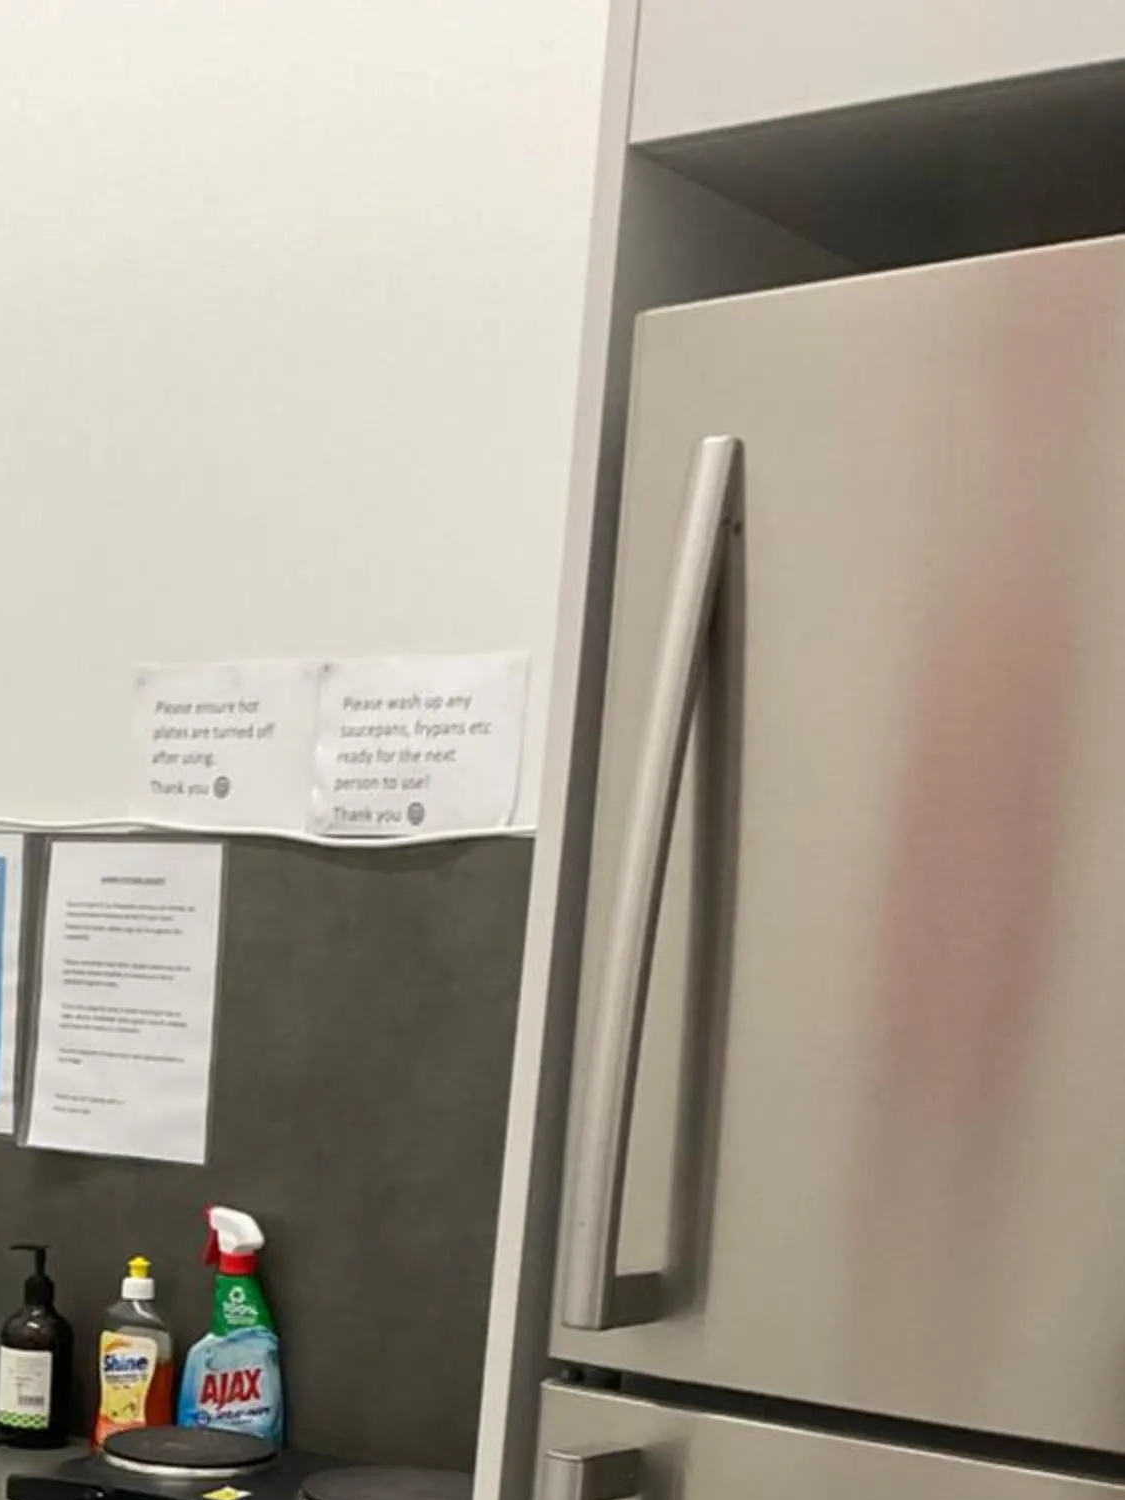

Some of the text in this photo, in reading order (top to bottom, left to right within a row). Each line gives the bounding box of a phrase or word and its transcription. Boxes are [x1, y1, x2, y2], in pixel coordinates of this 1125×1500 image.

[155, 701, 192, 714] Please
[343, 694, 473, 711] Please wash up any
[153, 723, 276, 742] plates are turned off
[414, 721, 466, 739] frypans
[469, 722, 492, 735] etc
[152, 750, 179, 764] after
[337, 748, 456, 766] ready for the next
[150, 780, 209, 797] Thank you
[334, 777, 379, 791] person
[382, 777, 398, 790] to
[334, 806, 402, 824] Thank you
[104, 1355, 149, 1373] Shine
[200, 1367, 263, 1411] AJAX
